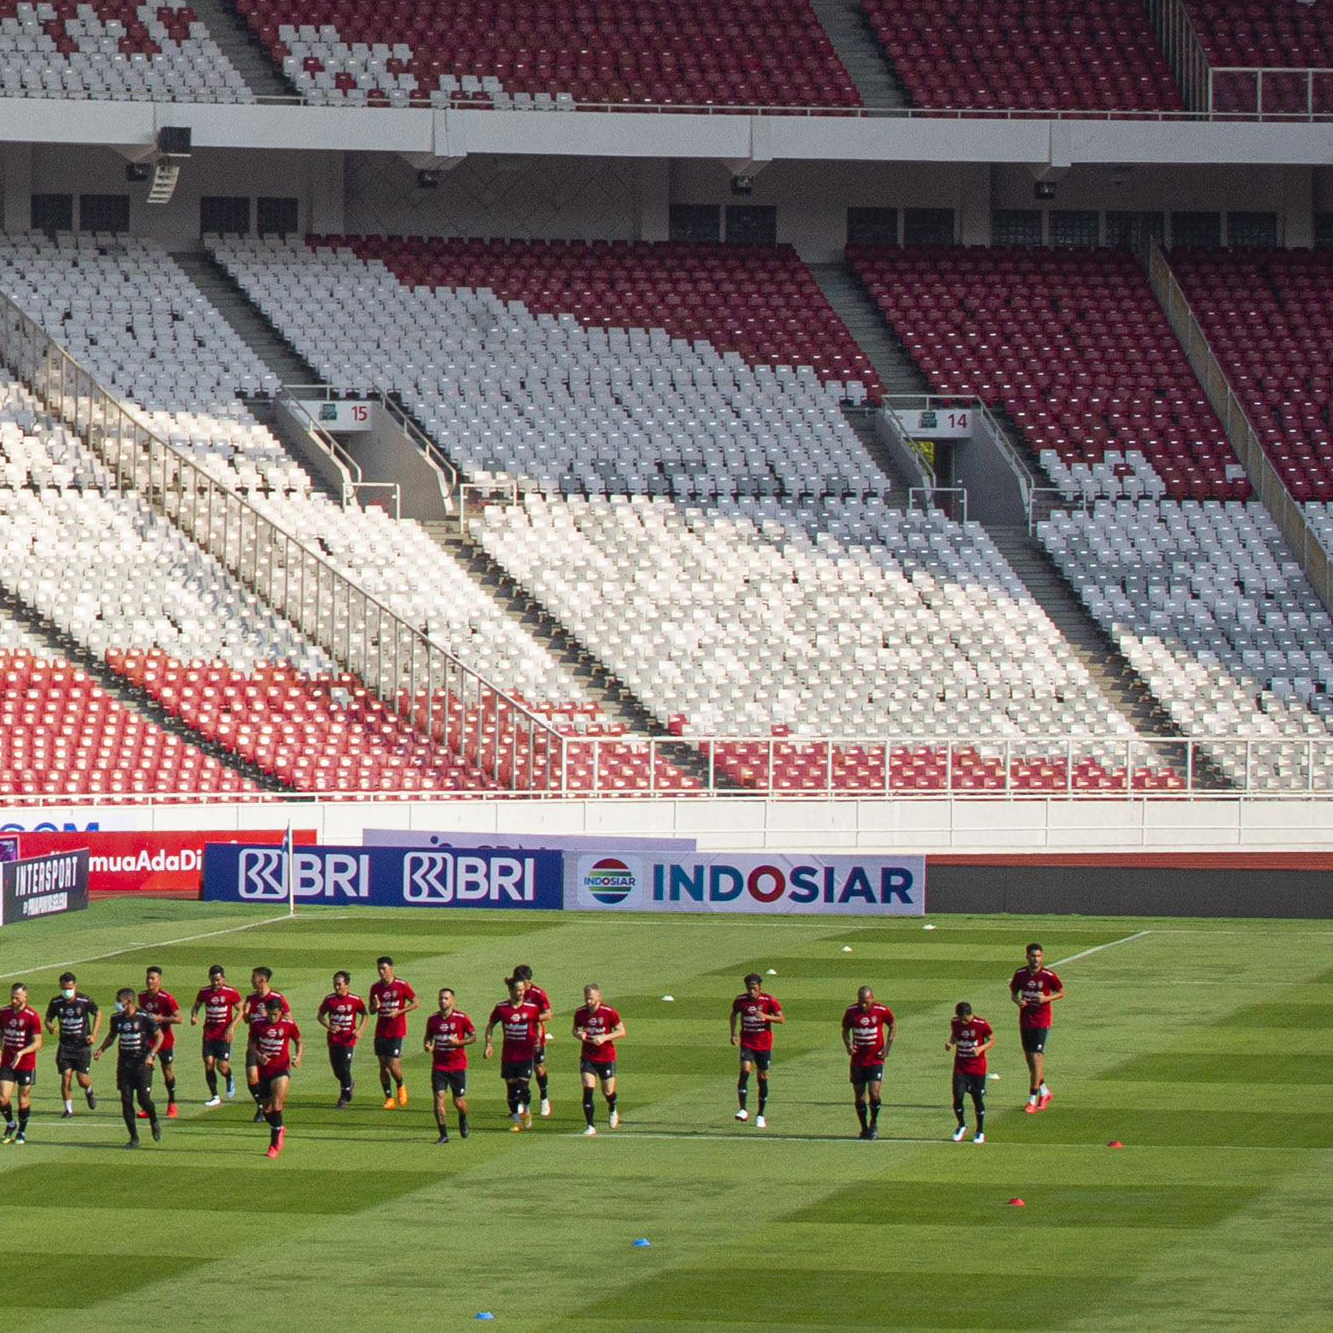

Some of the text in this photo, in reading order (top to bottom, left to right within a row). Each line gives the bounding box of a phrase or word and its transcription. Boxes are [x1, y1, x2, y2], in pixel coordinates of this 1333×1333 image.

[351, 405, 367, 421] 15
[948, 413, 967, 428] 14
[15, 856, 77, 897] INTERSPORT
[88, 849, 203, 872] muaAdaDi
[294, 854, 369, 898] BRI
[457, 857, 534, 901] BRI
[584, 877, 636, 887] INDOSIAR
[653, 864, 914, 905] INDOSIAR
